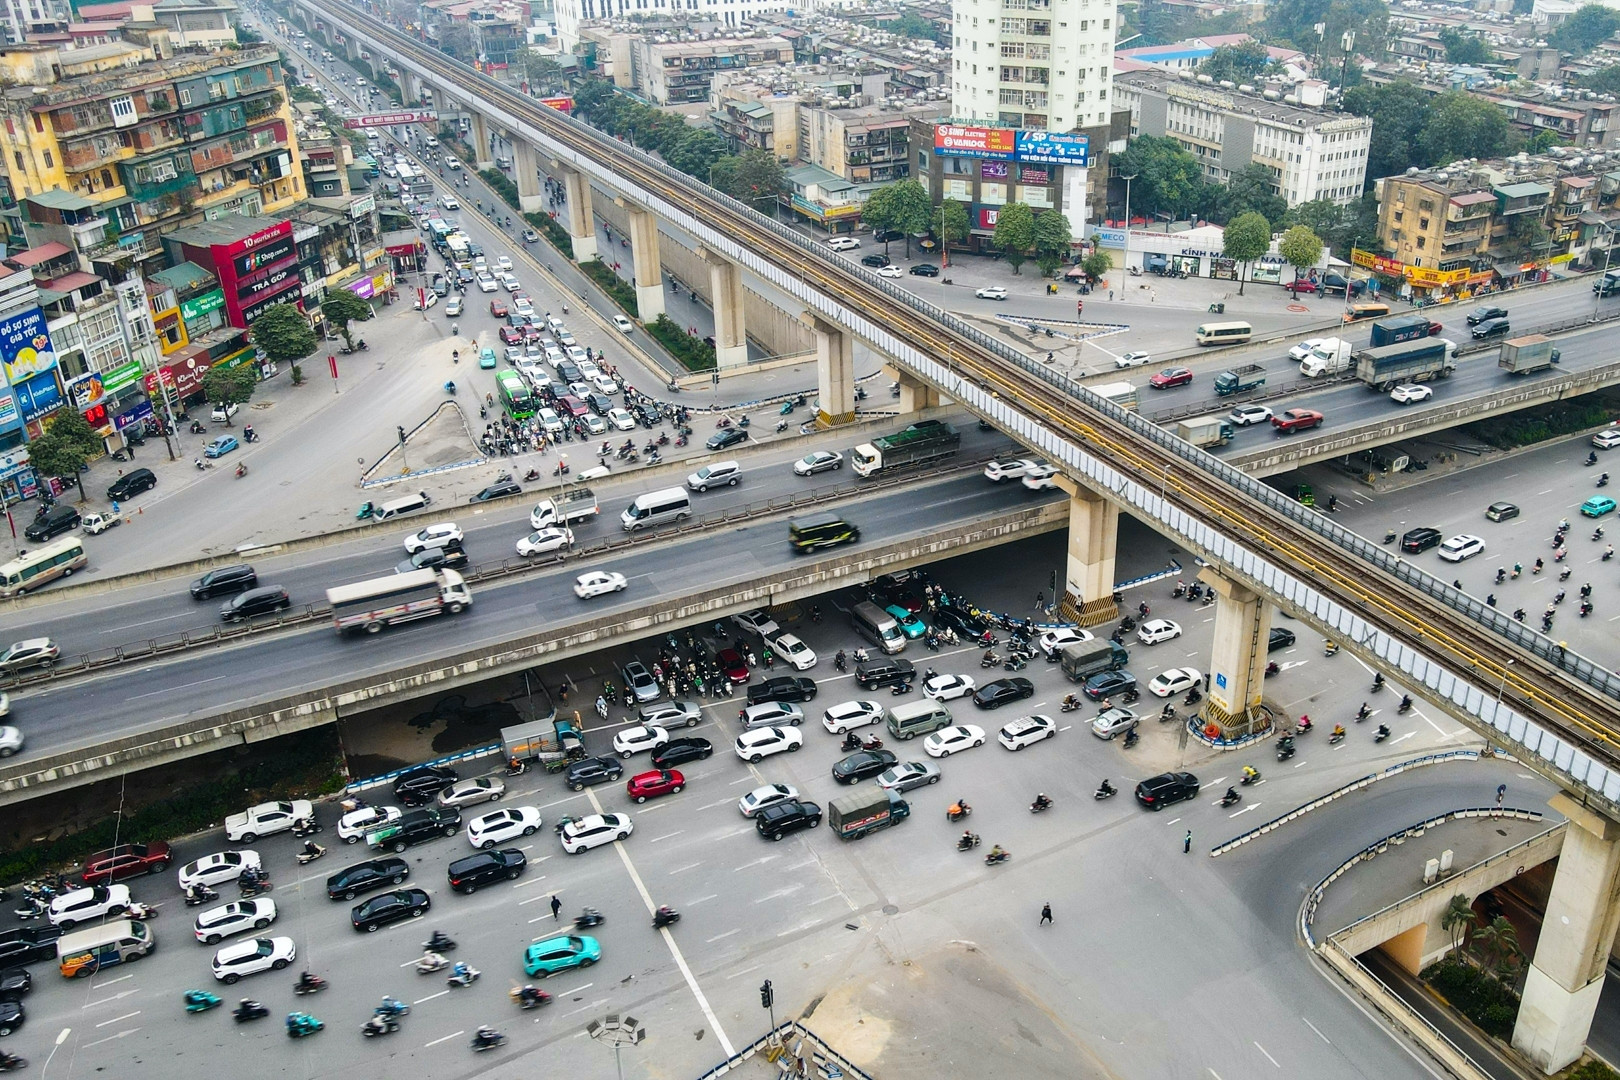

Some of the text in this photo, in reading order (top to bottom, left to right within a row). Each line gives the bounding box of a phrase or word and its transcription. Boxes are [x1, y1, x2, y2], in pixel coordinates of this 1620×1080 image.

[953, 138, 986, 148] VANLOCK
[1032, 132, 1047, 142] SP
[243, 238, 254, 248] 10
[245, 253, 260, 271] FPT
[1182, 248, 1206, 256] KÍNH
[1261, 256, 1288, 264] NAM
[252, 272, 287, 292] TRẢ GÓP
[1, 322, 12, 336] ĐỒ
[22, 314, 40, 327] SINH
[23, 325, 36, 338] TỐT
